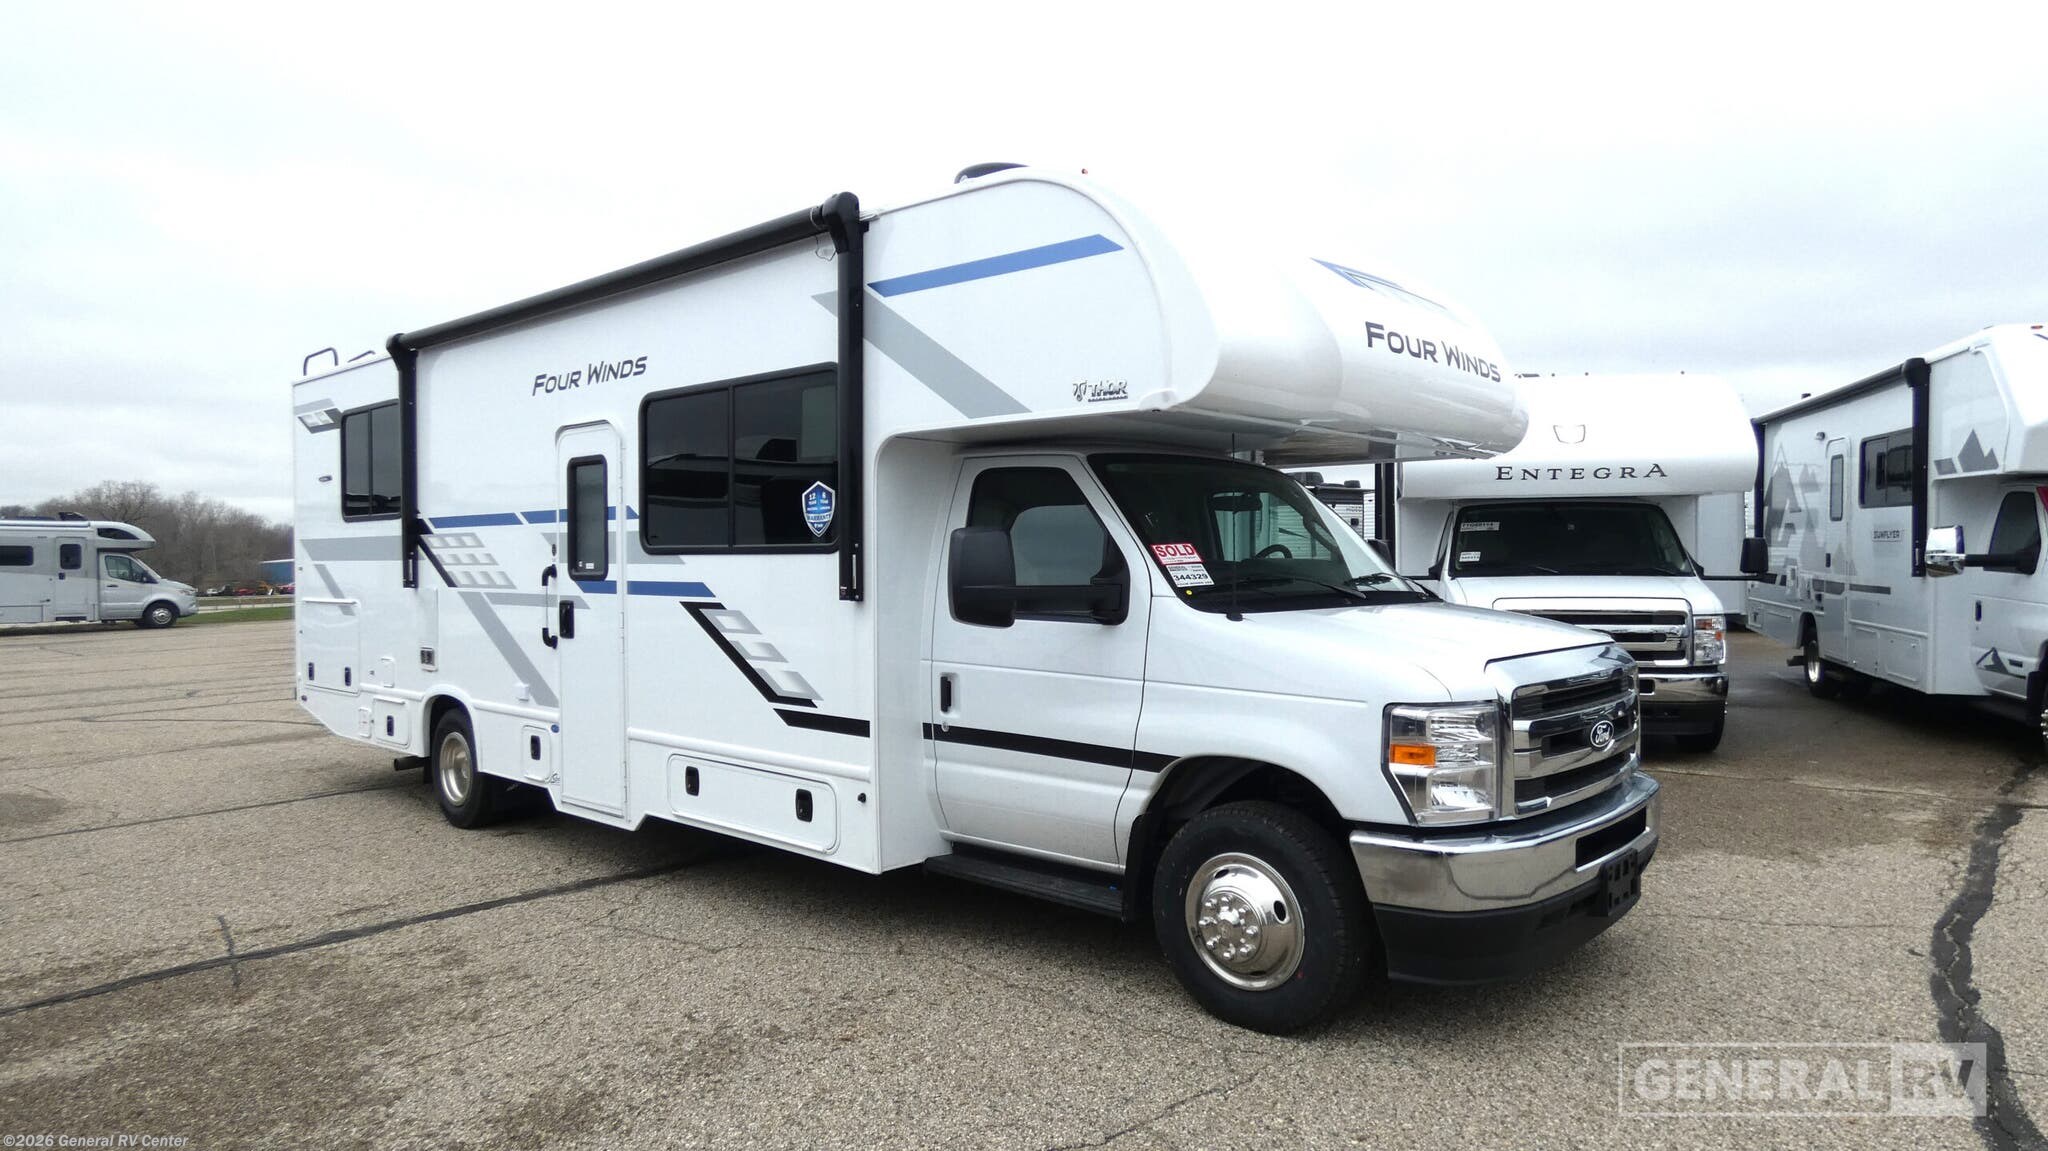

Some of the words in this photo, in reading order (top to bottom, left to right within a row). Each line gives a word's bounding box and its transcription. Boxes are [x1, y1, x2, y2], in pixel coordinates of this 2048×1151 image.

[1365, 321, 1438, 363] FOUR
[1441, 340, 1501, 382] WINDS
[532, 370, 581, 396] FOUR
[587, 356, 648, 385] WINDS
[1496, 463, 1667, 480] ENTEGRA
[1155, 544, 1195, 557] SOLD
[1594, 723, 1612, 744] Ford
